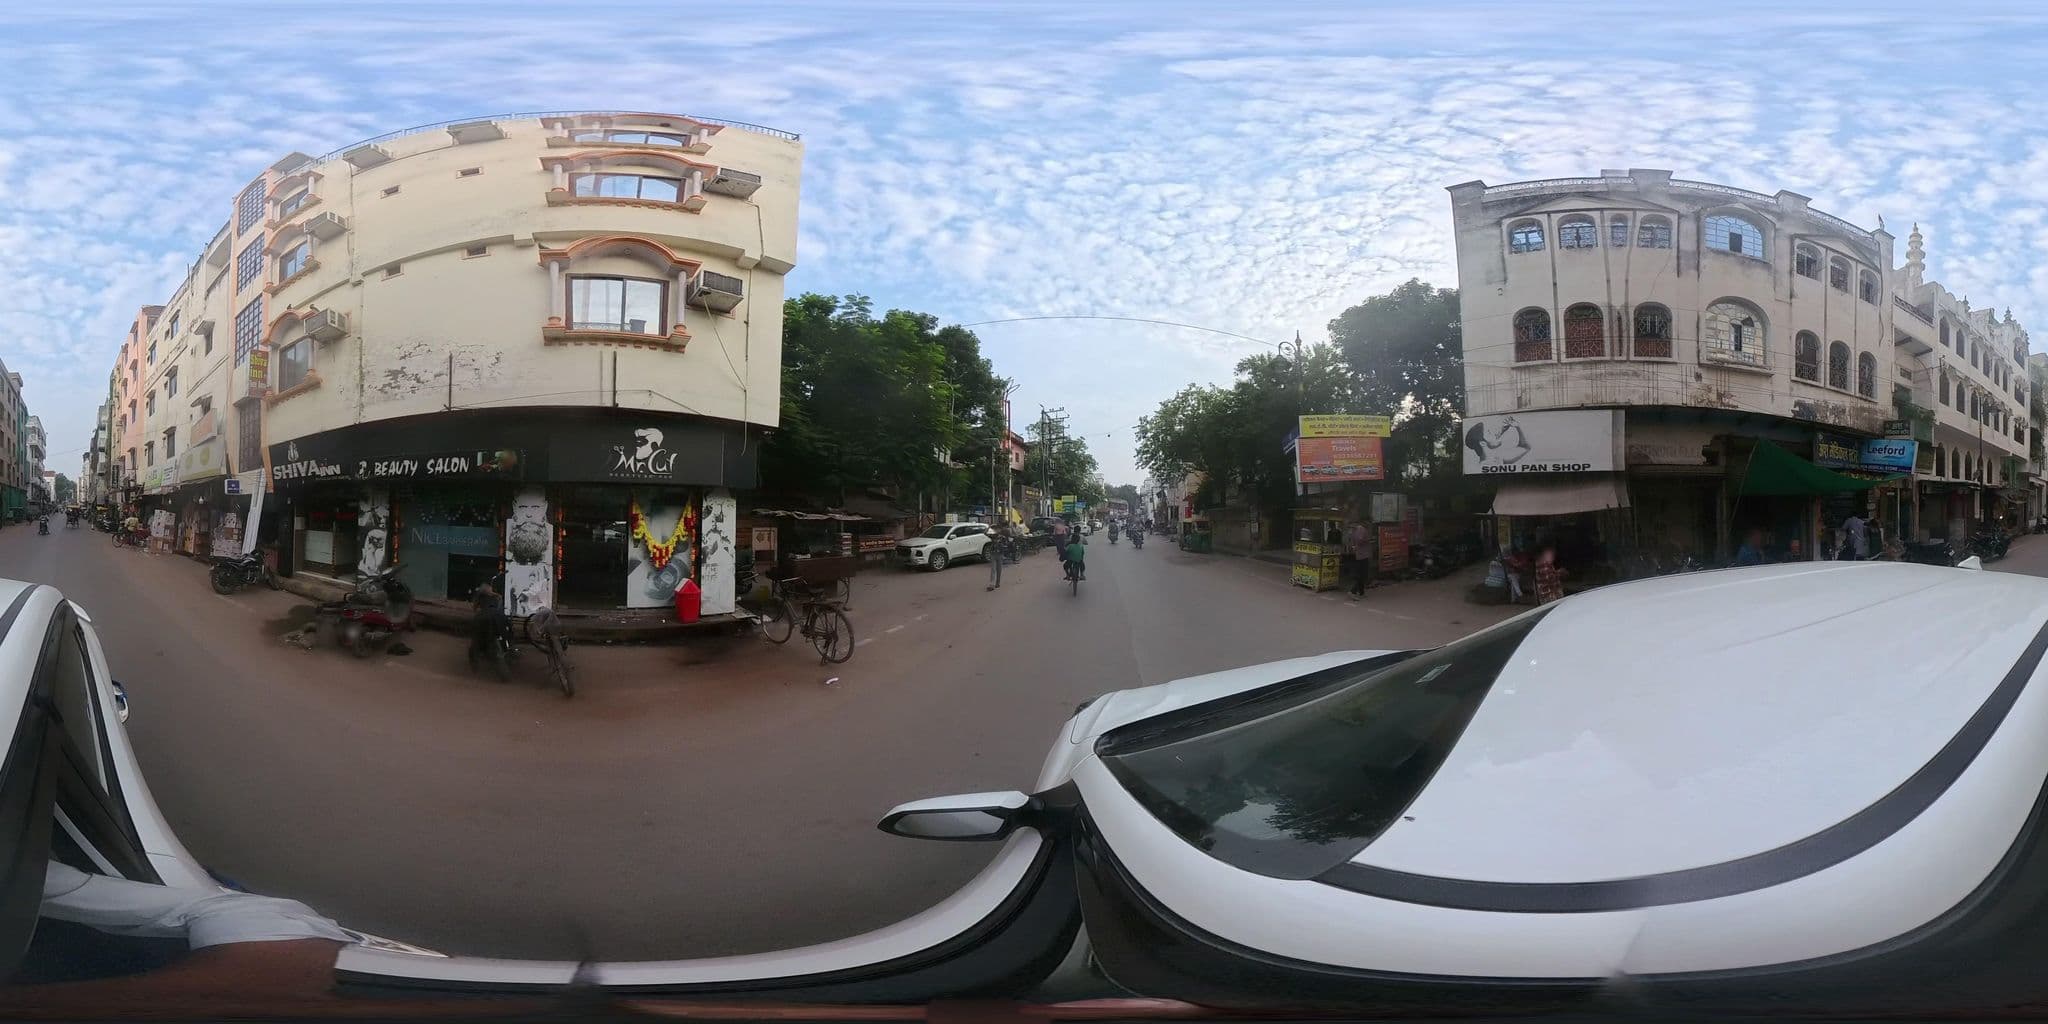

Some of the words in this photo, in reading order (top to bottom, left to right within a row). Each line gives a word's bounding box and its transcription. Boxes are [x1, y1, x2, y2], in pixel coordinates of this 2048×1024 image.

[1867, 445, 1906, 456] Leeford
[273, 460, 320, 480] SHIVA
[374, 459, 418, 477] BEAUTY
[426, 457, 470, 474] SALON
[1482, 465, 1517, 473] SONU
[1521, 464, 1548, 472] PAN
[1552, 463, 1591, 471] SHOP
